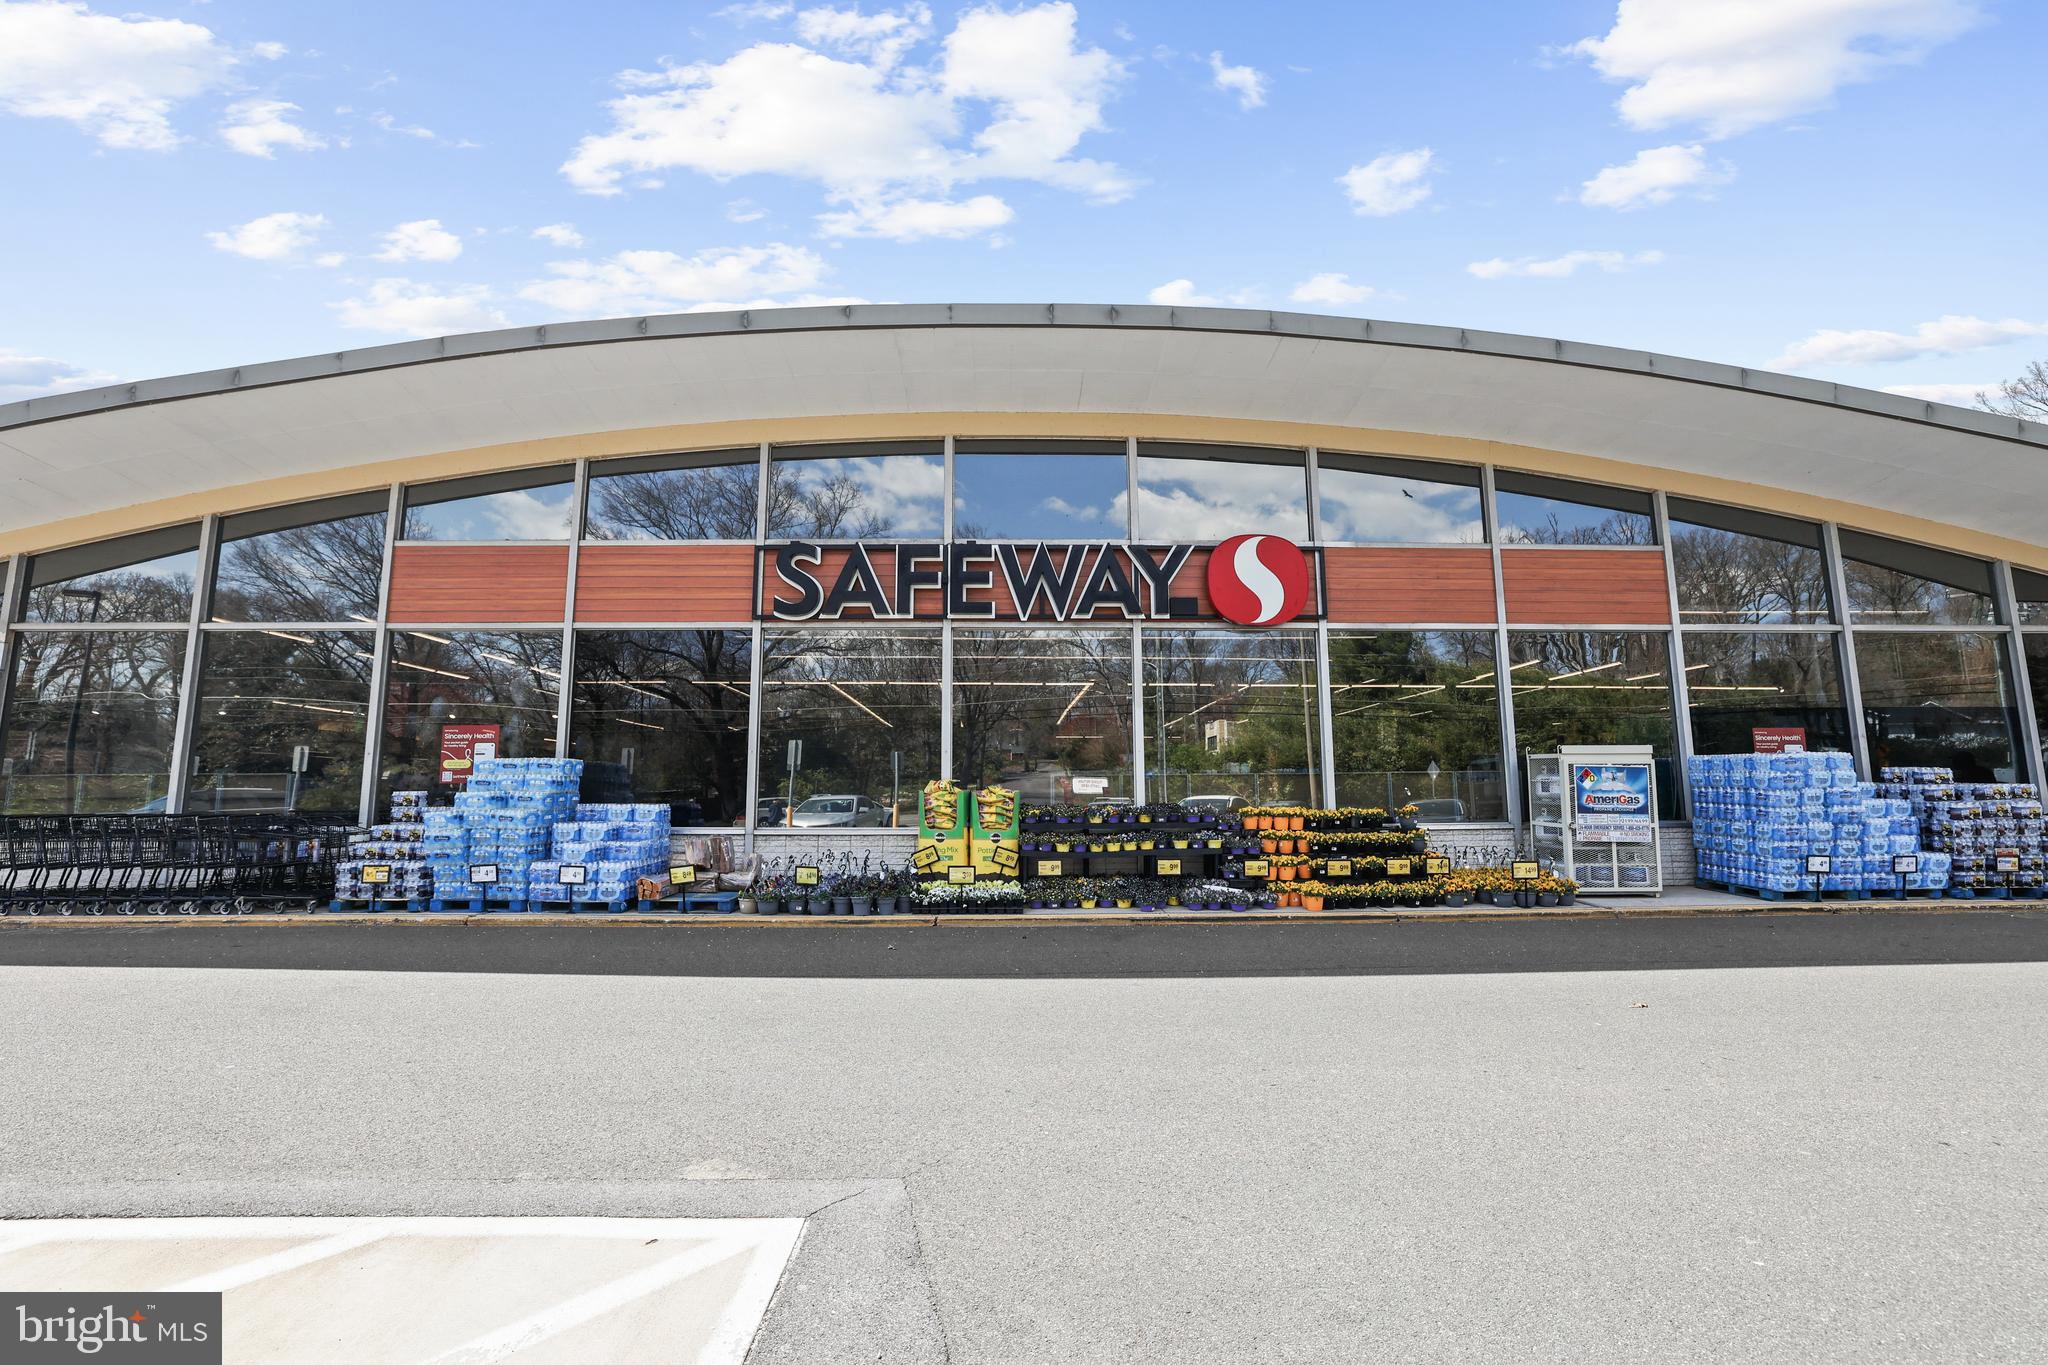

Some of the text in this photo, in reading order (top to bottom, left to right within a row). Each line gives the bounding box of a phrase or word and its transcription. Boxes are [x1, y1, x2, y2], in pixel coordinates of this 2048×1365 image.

[772, 540, 1194, 621] SAFEWAY
[444, 733, 472, 741] Sincerely
[1585, 795, 1640, 804] AmeriGas
